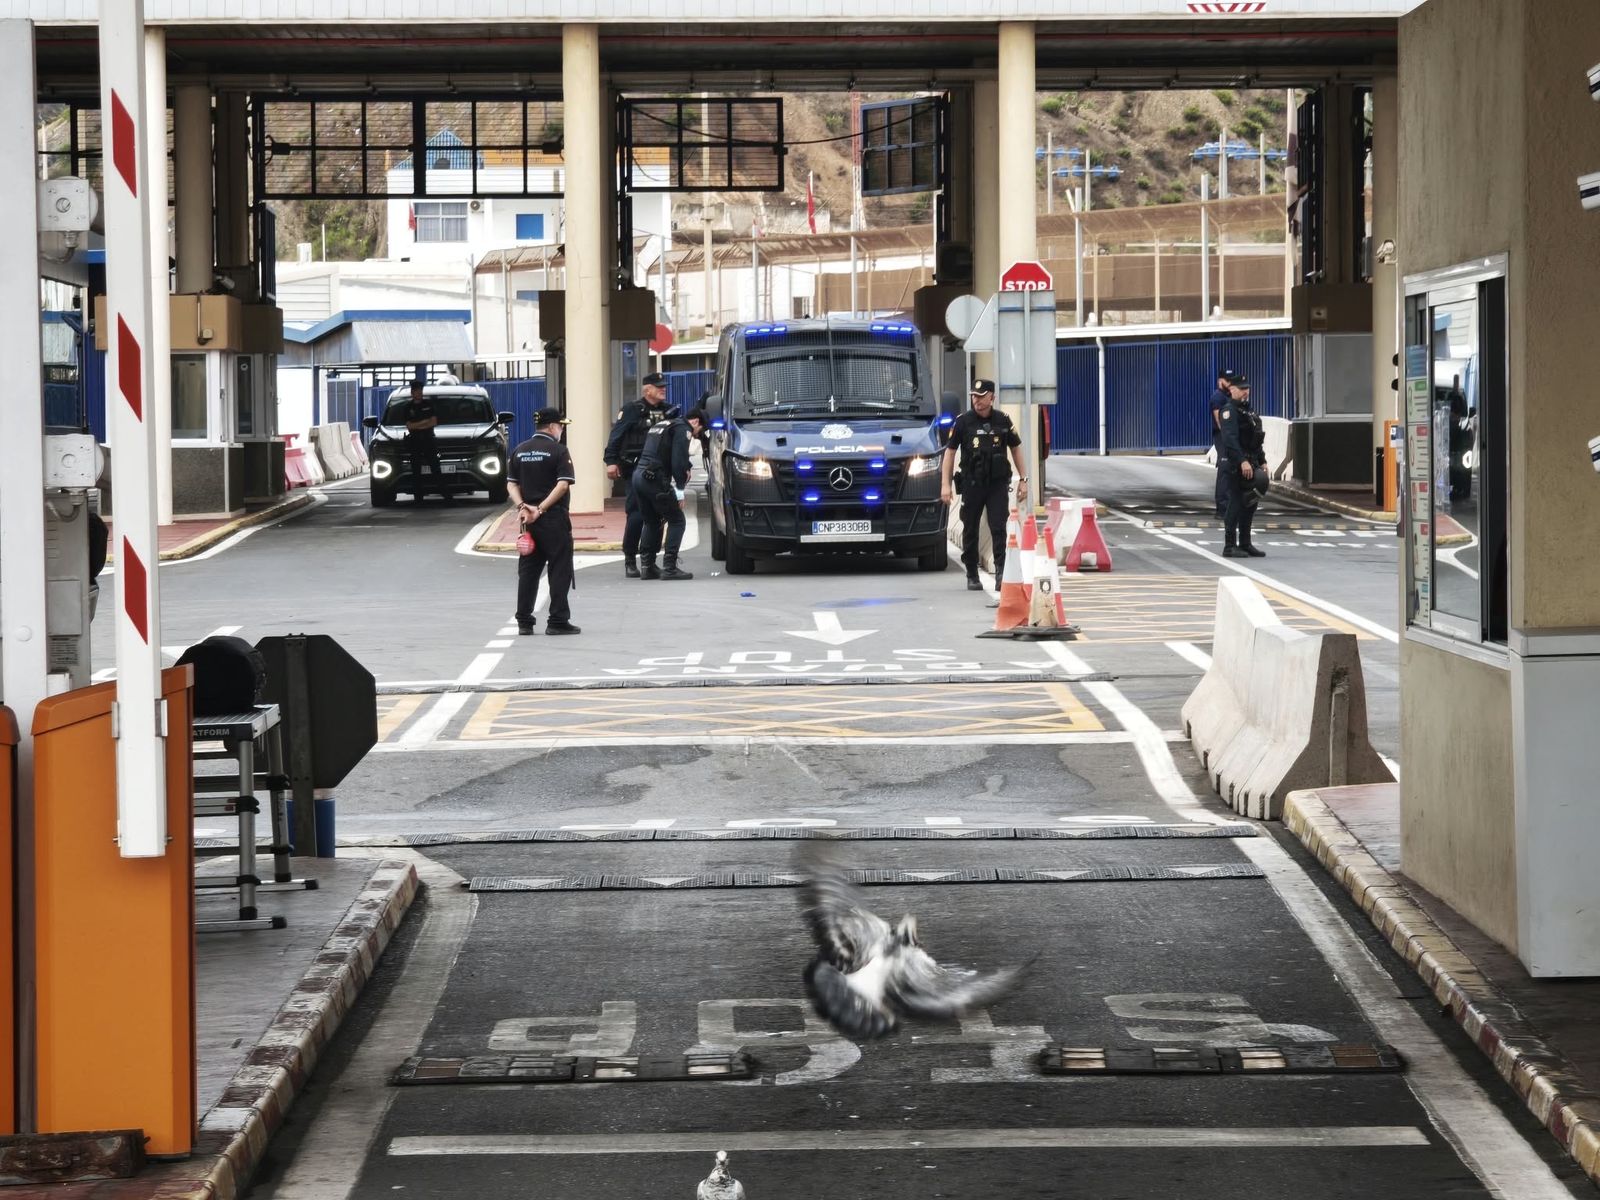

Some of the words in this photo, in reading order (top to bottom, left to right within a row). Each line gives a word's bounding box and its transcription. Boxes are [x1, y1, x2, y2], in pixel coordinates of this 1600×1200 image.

[1005, 280, 1048, 291] STOP
[794, 445, 867, 454] POLICIA
[637, 648, 957, 666] STOP
[601, 661, 1059, 675] ADUANA
